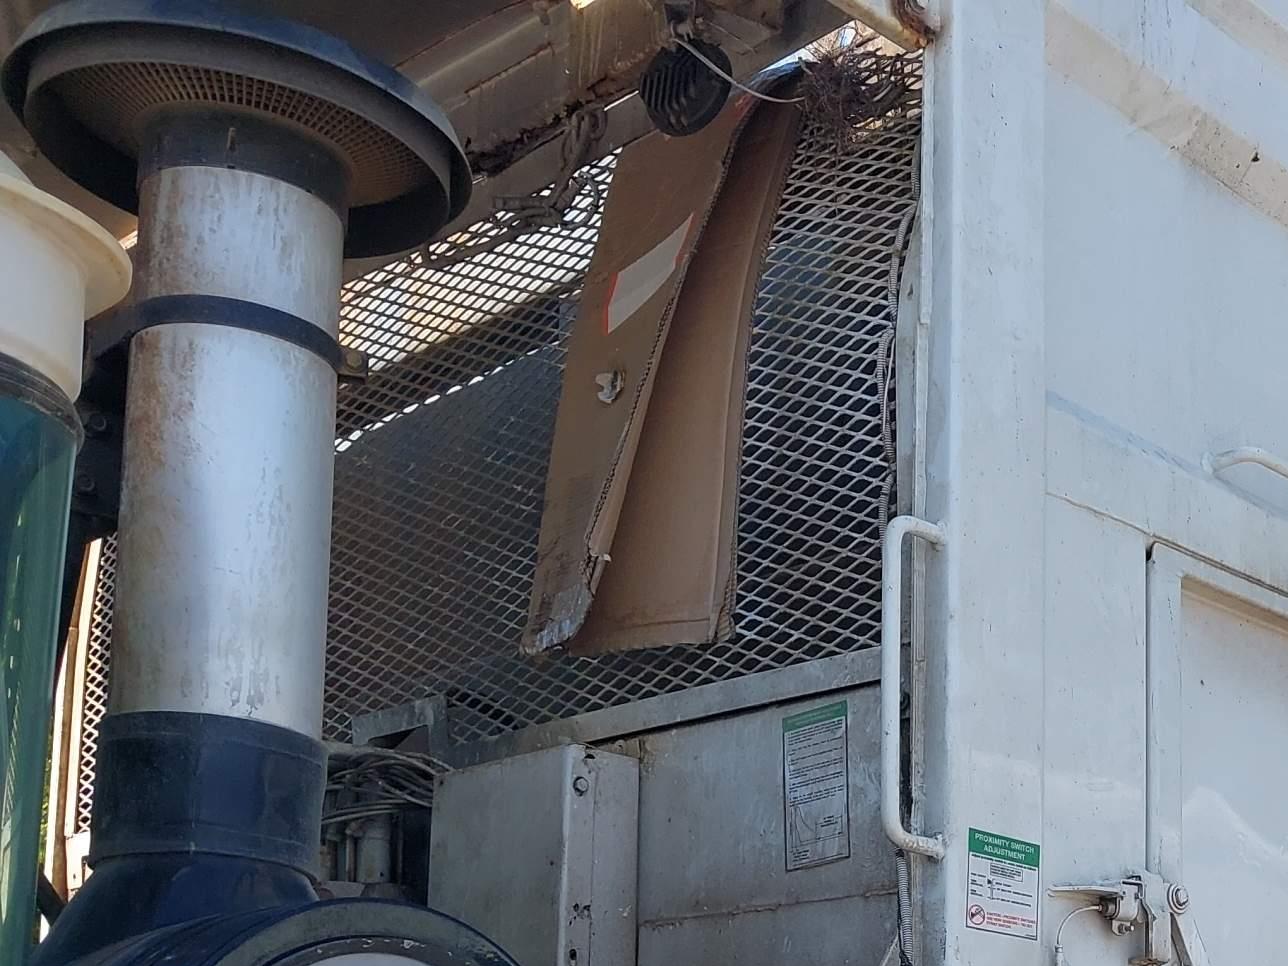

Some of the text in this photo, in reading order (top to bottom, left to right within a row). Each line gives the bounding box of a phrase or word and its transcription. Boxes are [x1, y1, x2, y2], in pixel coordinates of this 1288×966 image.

[975, 833, 1034, 854] PROXIMITY SWITCH
[984, 845, 1025, 861] ADJUSTMENT
